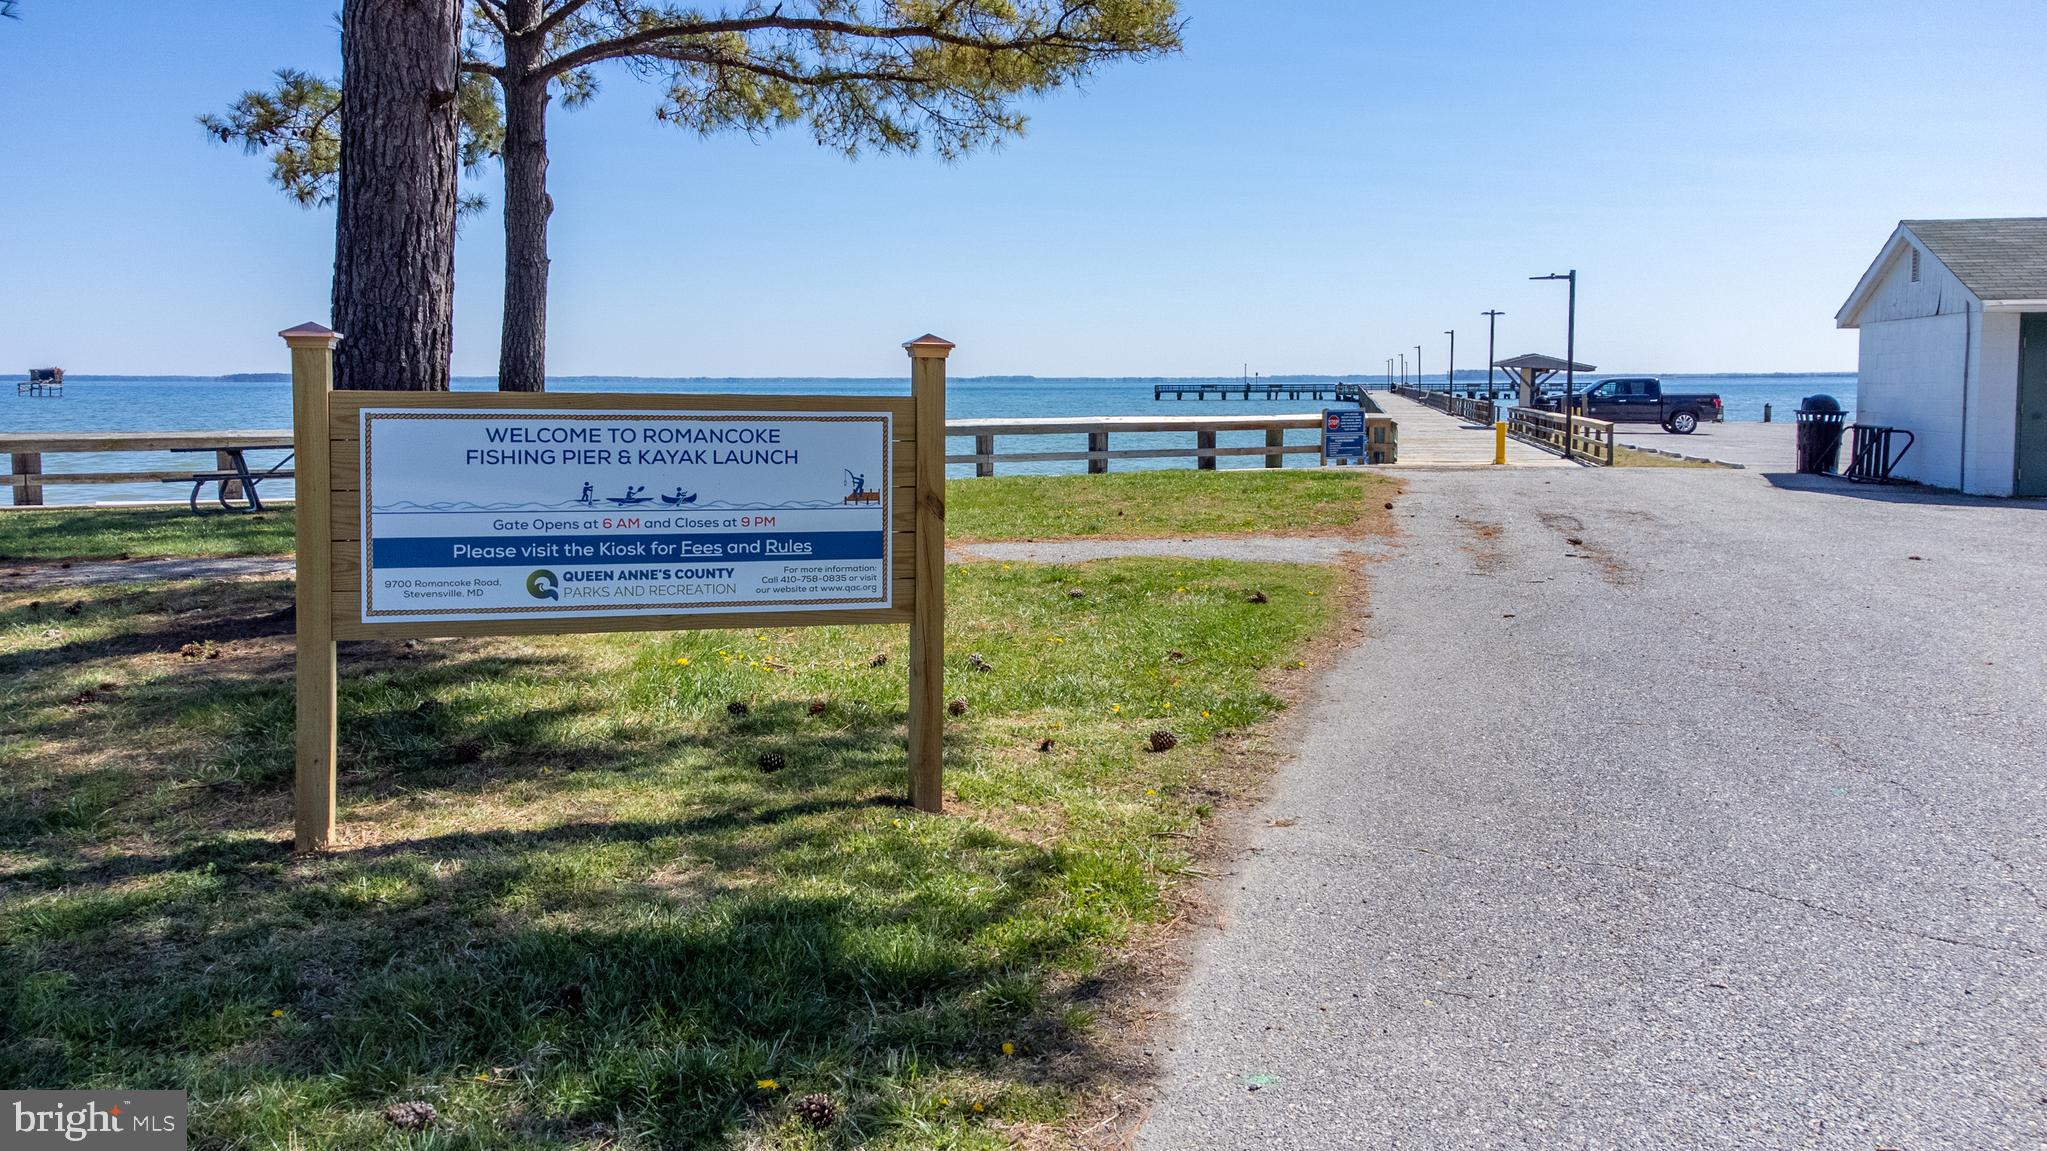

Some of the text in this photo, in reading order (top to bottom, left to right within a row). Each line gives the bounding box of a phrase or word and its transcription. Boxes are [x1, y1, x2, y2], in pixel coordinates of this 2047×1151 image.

[485, 427, 781, 444] WELCOME TO ROMANCOKE
[466, 449, 798, 465] FISHING PIER & KAYAK LAUNCH
[493, 516, 776, 533] Gate Opens at 6 AM and Closes at 9 PM
[453, 539, 813, 559] Please visit the Kiosk for Fees and Rules
[562, 567, 735, 582] QUEEN ANNE'S COUNTY
[783, 566, 799, 574] For
[824, 565, 877, 573] information:
[384, 578, 502, 588] 9700 Romancoke Road,
[761, 576, 779, 584] Call
[780, 574, 847, 583] 410-758-0835
[403, 589, 484, 598] Stevensville, MD
[563, 583, 736, 598] PARKS AND RECREATION
[773, 585, 807, 593] website
[820, 584, 877, 593] www.qac.org
